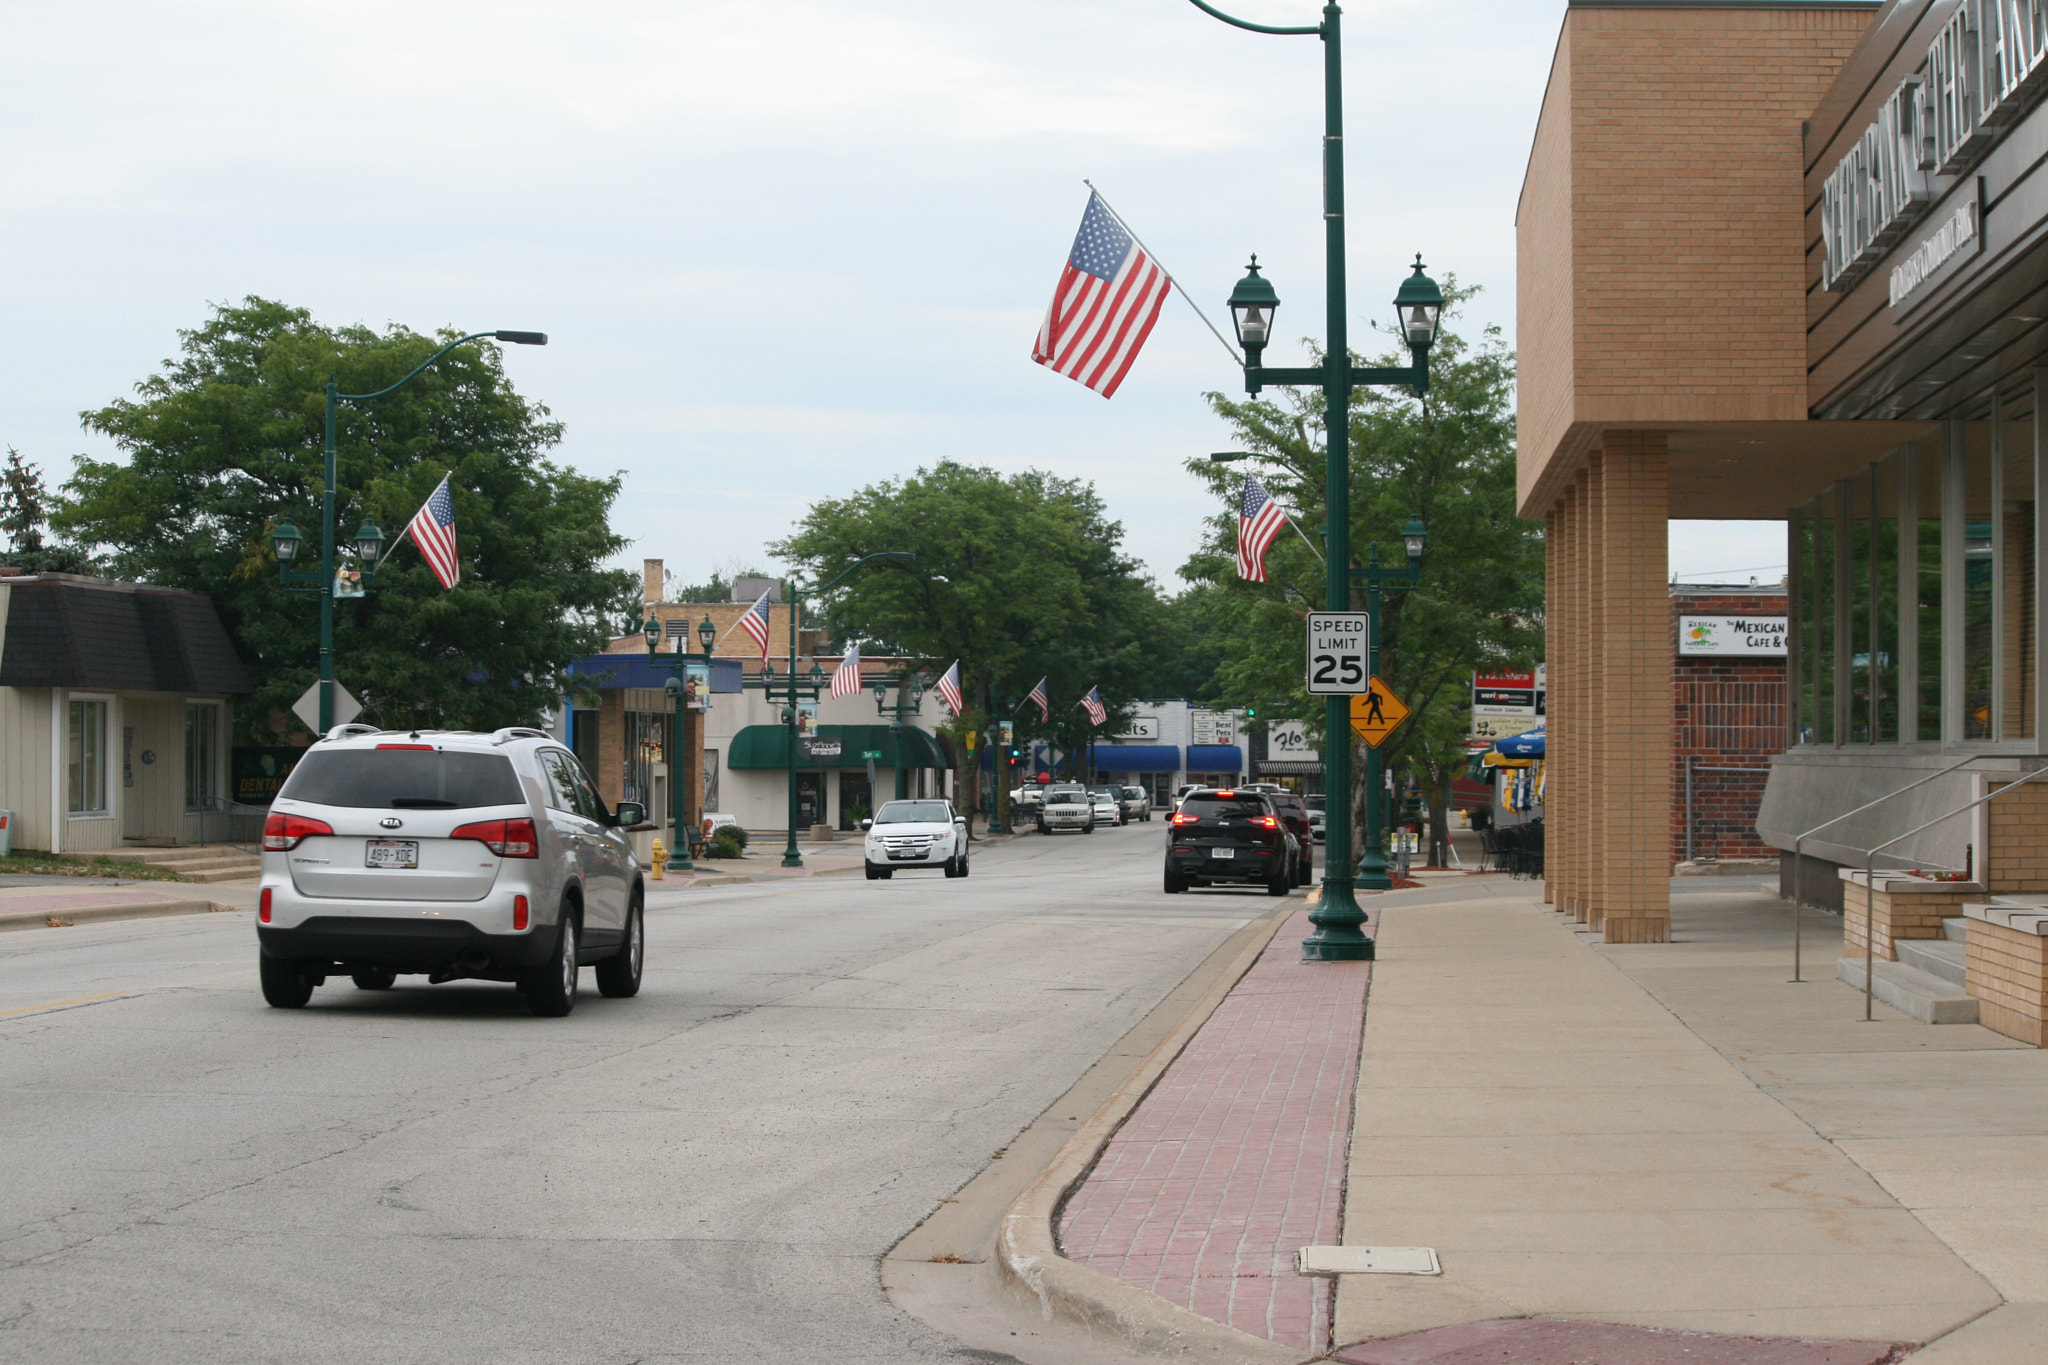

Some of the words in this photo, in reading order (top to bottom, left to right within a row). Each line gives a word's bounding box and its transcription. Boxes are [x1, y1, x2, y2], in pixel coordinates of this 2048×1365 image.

[1313, 621, 1363, 632] SPEED
[1734, 620, 1785, 633] MEXICAN
[1318, 638, 1357, 649] LIMIT
[1746, 635, 1770, 647] CAFE
[1773, 635, 1782, 647] &
[1313, 654, 1363, 685] 25
[382, 819, 401, 827] KIA
[370, 848, 414, 862] 489-XDE
